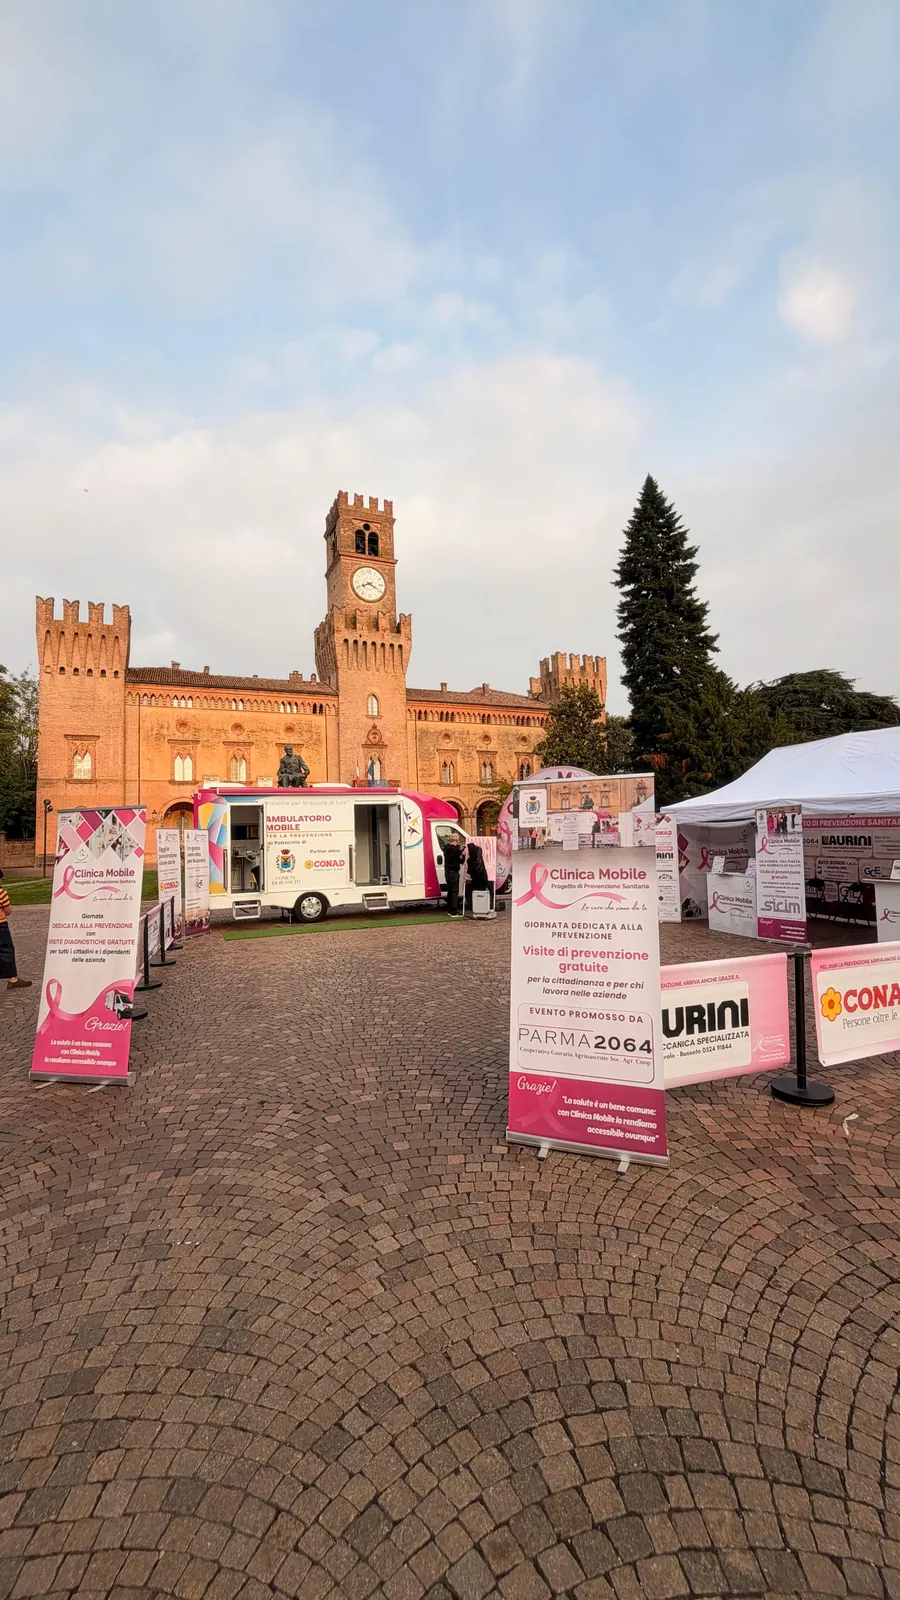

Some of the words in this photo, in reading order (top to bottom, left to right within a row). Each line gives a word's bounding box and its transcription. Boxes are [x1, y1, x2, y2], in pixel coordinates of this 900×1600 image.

[266, 815, 332, 823] AMBULATORIO
[820, 819, 866, 827] PREVENZIONE
[708, 848, 728, 856] Clinica
[728, 848, 748, 856] Mobile
[314, 859, 345, 868] CONAD
[74, 868, 104, 878] Clinica
[106, 868, 135, 878] Mobile
[550, 868, 595, 880] Clinica
[598, 868, 647, 880] Mobile
[864, 866, 881, 877] GCE
[718, 894, 735, 902] Clinica
[735, 896, 753, 904] Mobile
[580, 903, 590, 912] La
[605, 900, 615, 911] che
[631, 900, 640, 912] da
[641, 903, 648, 912] te
[760, 898, 800, 914] sicim
[524, 921, 569, 930] GIORNATA
[571, 922, 618, 930] DEDICATA
[551, 931, 612, 940] PREVENZIONE
[102, 948, 131, 956] dipendenti
[522, 945, 555, 956] Visite
[557, 946, 569, 957] di
[571, 948, 649, 960] prevenzione
[558, 962, 609, 974] gratuite
[844, 959, 870, 967] PREVENZIONE
[527, 976, 541, 984] per
[542, 976, 550, 984] la
[551, 976, 605, 987] cittadinanza
[613, 982, 628, 990] per
[630, 982, 644, 990] chi
[660, 980, 682, 989] ENZIONE
[682, 978, 700, 988] ARRIVA
[700, 977, 717, 985] ANCHE
[718, 975, 734, 983] GRAZIE
[542, 987, 569, 996] lavora
[570, 990, 591, 998] nelle
[592, 990, 627, 1000] aziende
[530, 1007, 566, 1017] EVENTO
[569, 1010, 626, 1022] PROMOSSO
[629, 1015, 644, 1024] DA
[662, 998, 750, 1038] URINI
[842, 1016, 871, 1030] Persone
[872, 1012, 890, 1024] oltre
[891, 1009, 898, 1020] le
[84, 1016, 129, 1032] Grazie!
[696, 1031, 750, 1046] SPECIALIZZATA
[519, 1046, 550, 1056] Cooperativa
[550, 1050, 573, 1058] Casearia
[574, 1052, 609, 1062] Agrinascente
[622, 1058, 634, 1066] Agr.
[635, 1059, 651, 1067] Coop
[680, 1048, 702, 1058] Busseto
[702, 1046, 716, 1054] 0524
[517, 1076, 557, 1096] Grazie!
[562, 1096, 572, 1104] "La
[573, 1098, 594, 1108] salute
[594, 1100, 599, 1108] è
[599, 1102, 608, 1110] un
[609, 1102, 625, 1112] bene
[626, 1106, 657, 1116] comune:
[557, 1110, 570, 1118] con
[570, 1110, 592, 1120] Clinica
[593, 1113, 615, 1124] Mobile
[623, 1118, 657, 1130] rendiamo
[587, 1126, 624, 1138] accessibile
[624, 1133, 660, 1144] ovunque"
